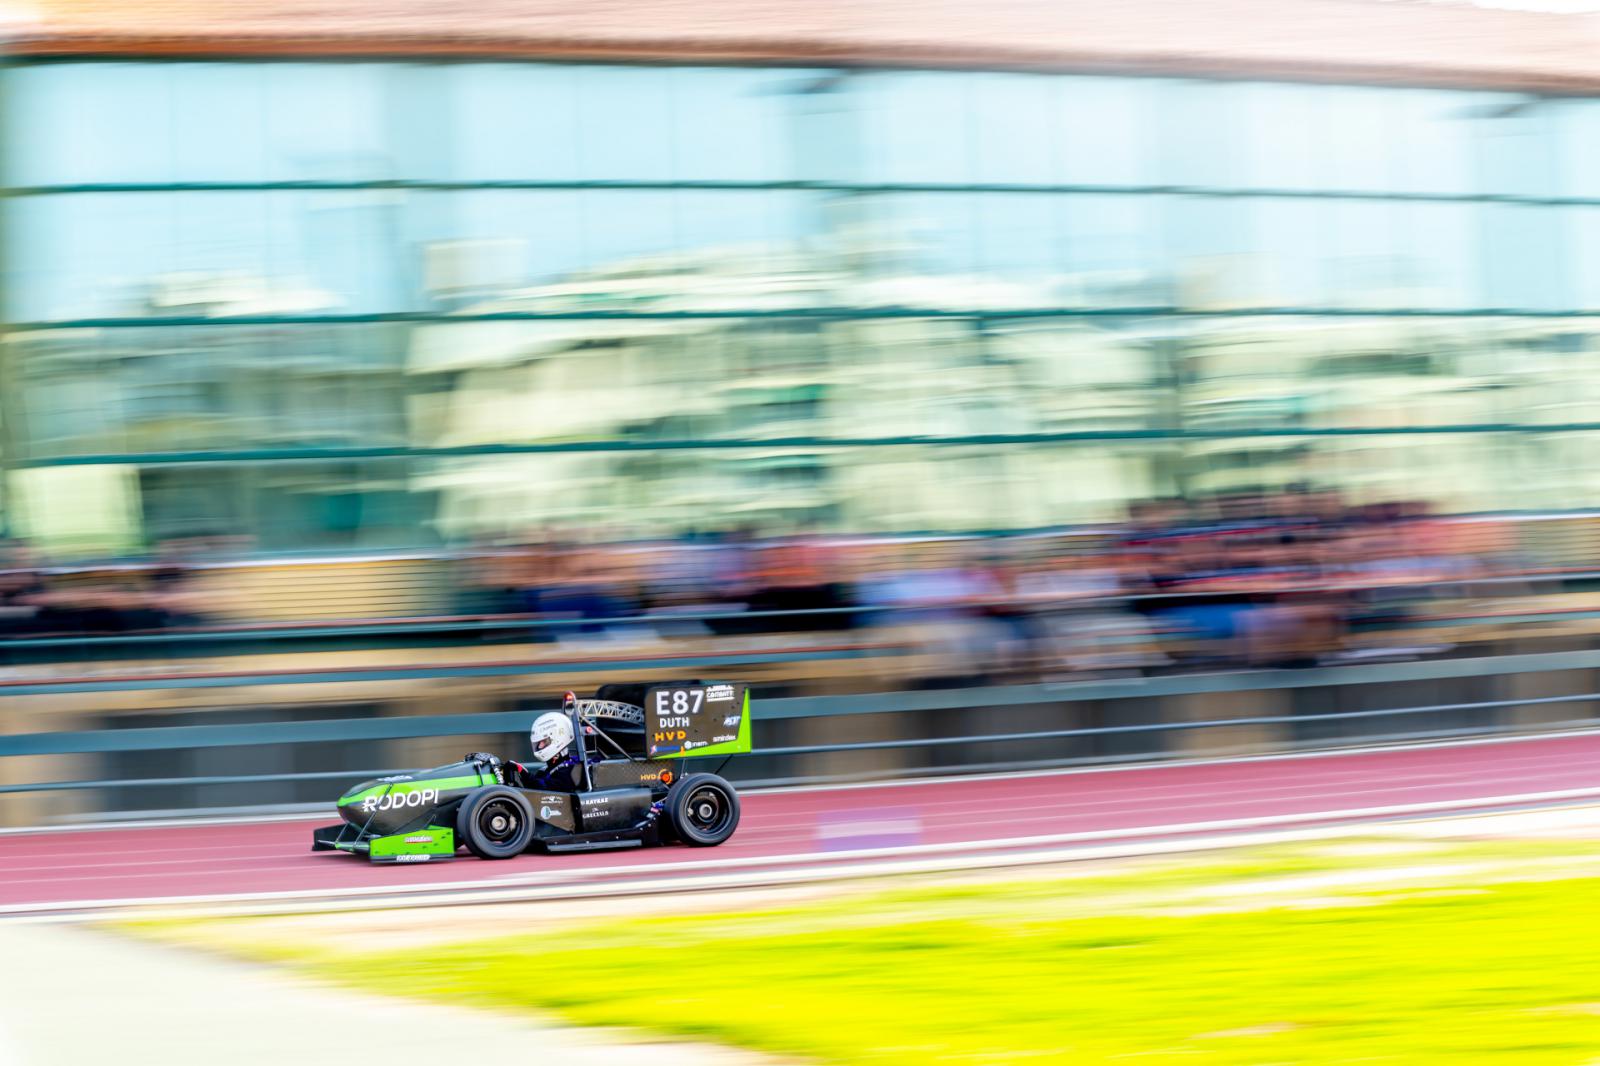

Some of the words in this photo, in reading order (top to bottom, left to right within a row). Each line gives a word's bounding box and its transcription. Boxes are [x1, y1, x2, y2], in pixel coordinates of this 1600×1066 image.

[656, 690, 704, 715] E87
[659, 716, 690, 728] DUTH
[655, 730, 687, 742] HVD
[362, 788, 439, 813] RODOPI
